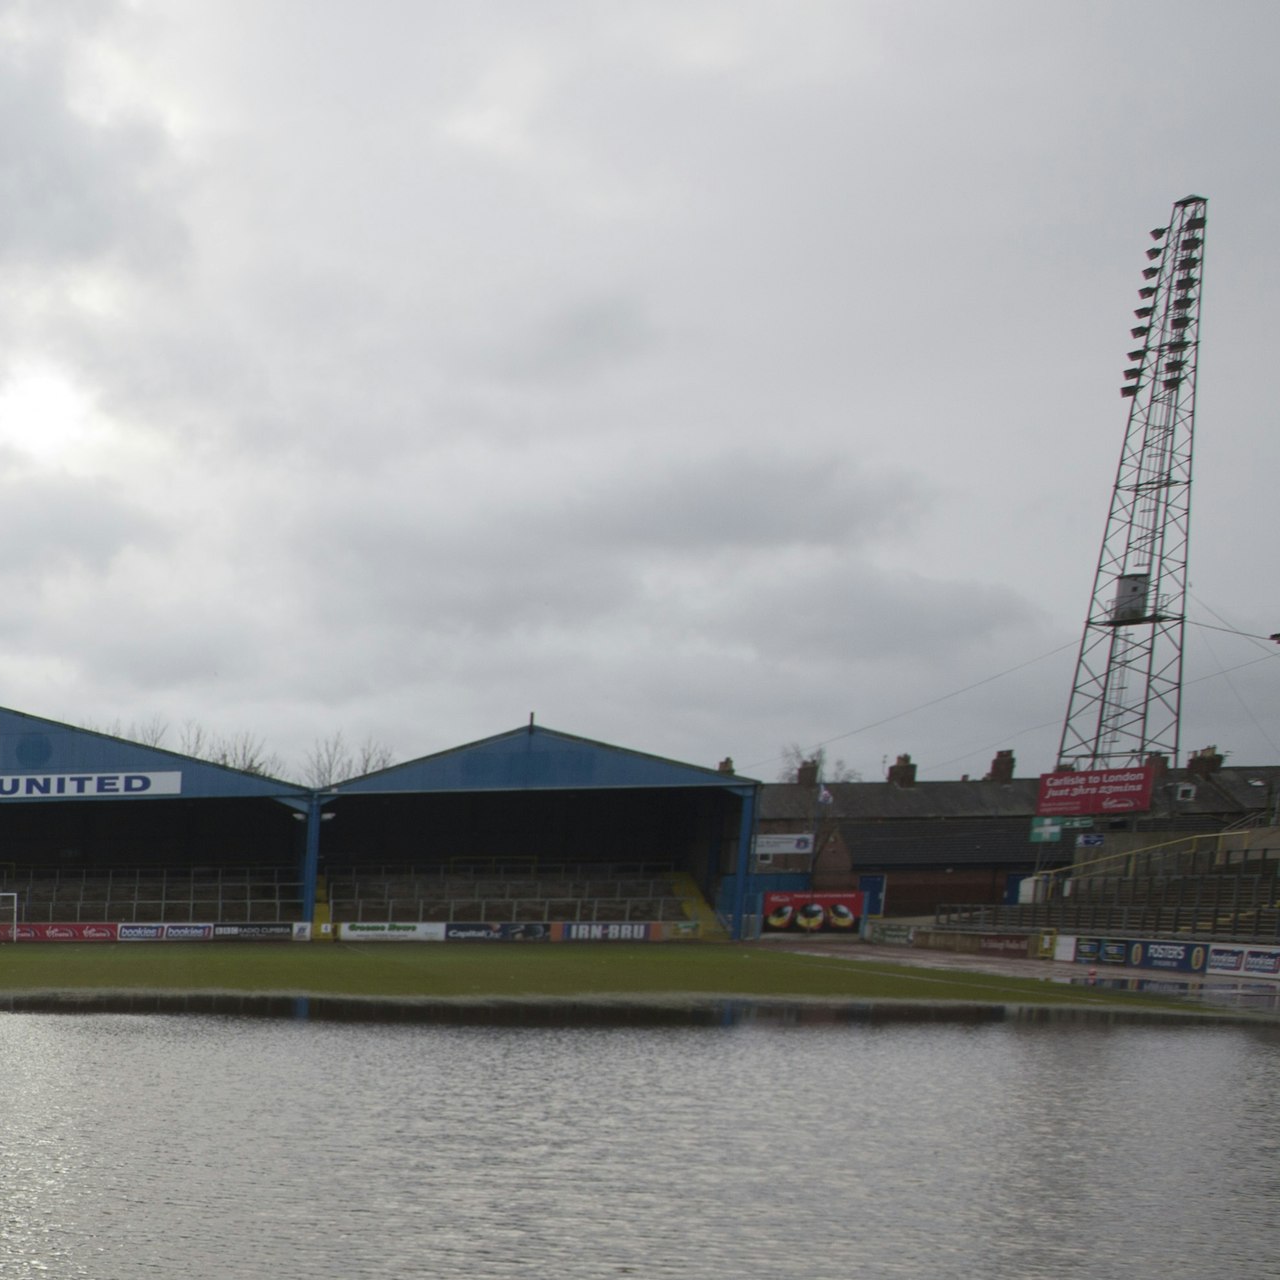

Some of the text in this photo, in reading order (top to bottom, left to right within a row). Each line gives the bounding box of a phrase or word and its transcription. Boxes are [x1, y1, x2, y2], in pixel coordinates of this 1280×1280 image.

[1046, 772, 1144, 787] Carlisle to London
[1045, 788, 1069, 799] just
[122, 928, 157, 937] bookies
[168, 928, 204, 937] bookies
[571, 924, 645, 939] IRN-BRU
